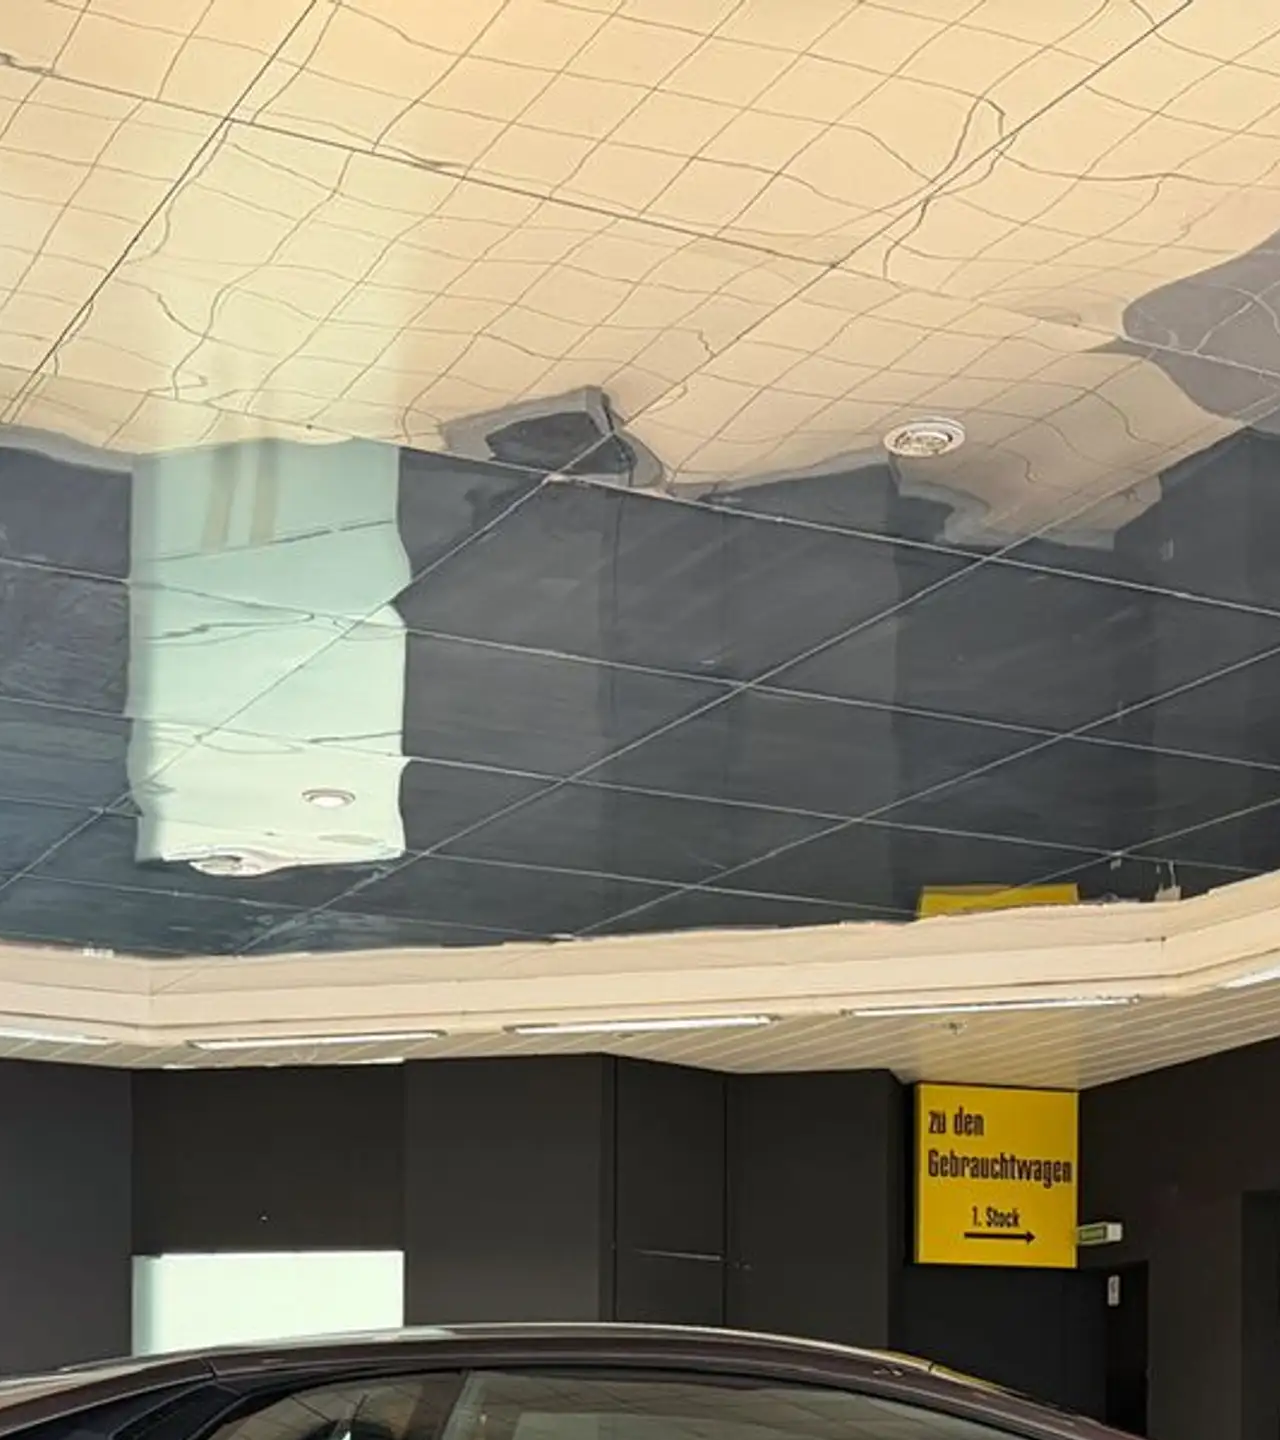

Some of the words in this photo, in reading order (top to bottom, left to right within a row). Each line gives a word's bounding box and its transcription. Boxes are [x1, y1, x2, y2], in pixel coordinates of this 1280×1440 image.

[928, 1110, 946, 1135] zu
[953, 1105, 985, 1137] den
[927, 1148, 1073, 1189] Gebrauchtwagen
[971, 1205, 983, 1228] 1.
[986, 1206, 1021, 1229] Stock
